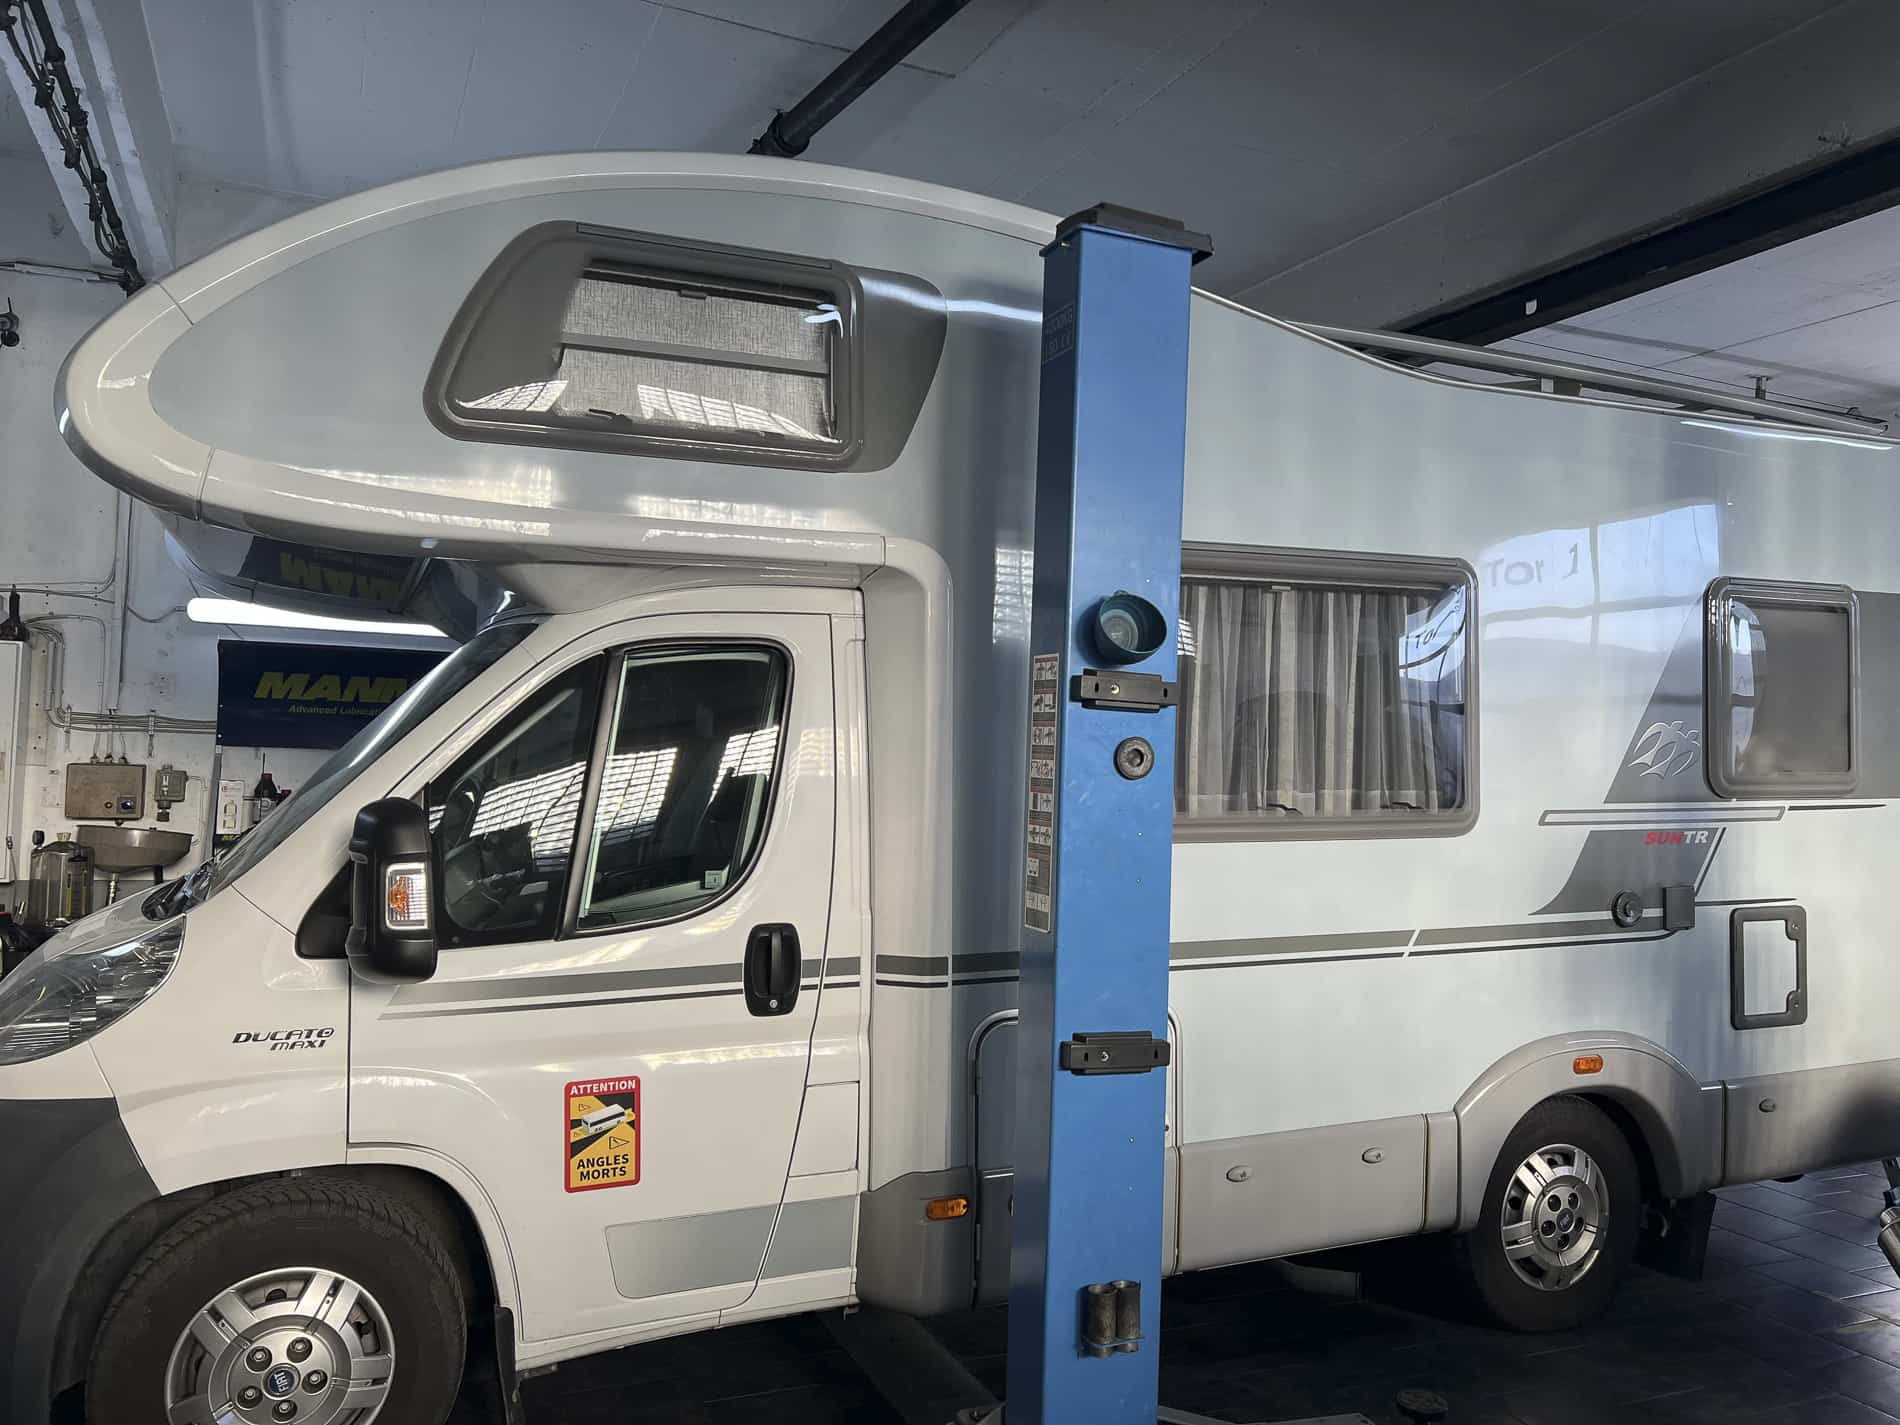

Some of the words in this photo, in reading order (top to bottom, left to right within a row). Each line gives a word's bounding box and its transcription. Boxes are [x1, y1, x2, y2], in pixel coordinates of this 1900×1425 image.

[288, 704, 337, 715] Advanced
[232, 1028, 334, 1043] DUCATO
[571, 1080, 635, 1095] ATTENTION
[577, 1154, 629, 1169] ANGLES
[581, 1167, 627, 1181] MORTS
[274, 1371, 289, 1392] FIAT
